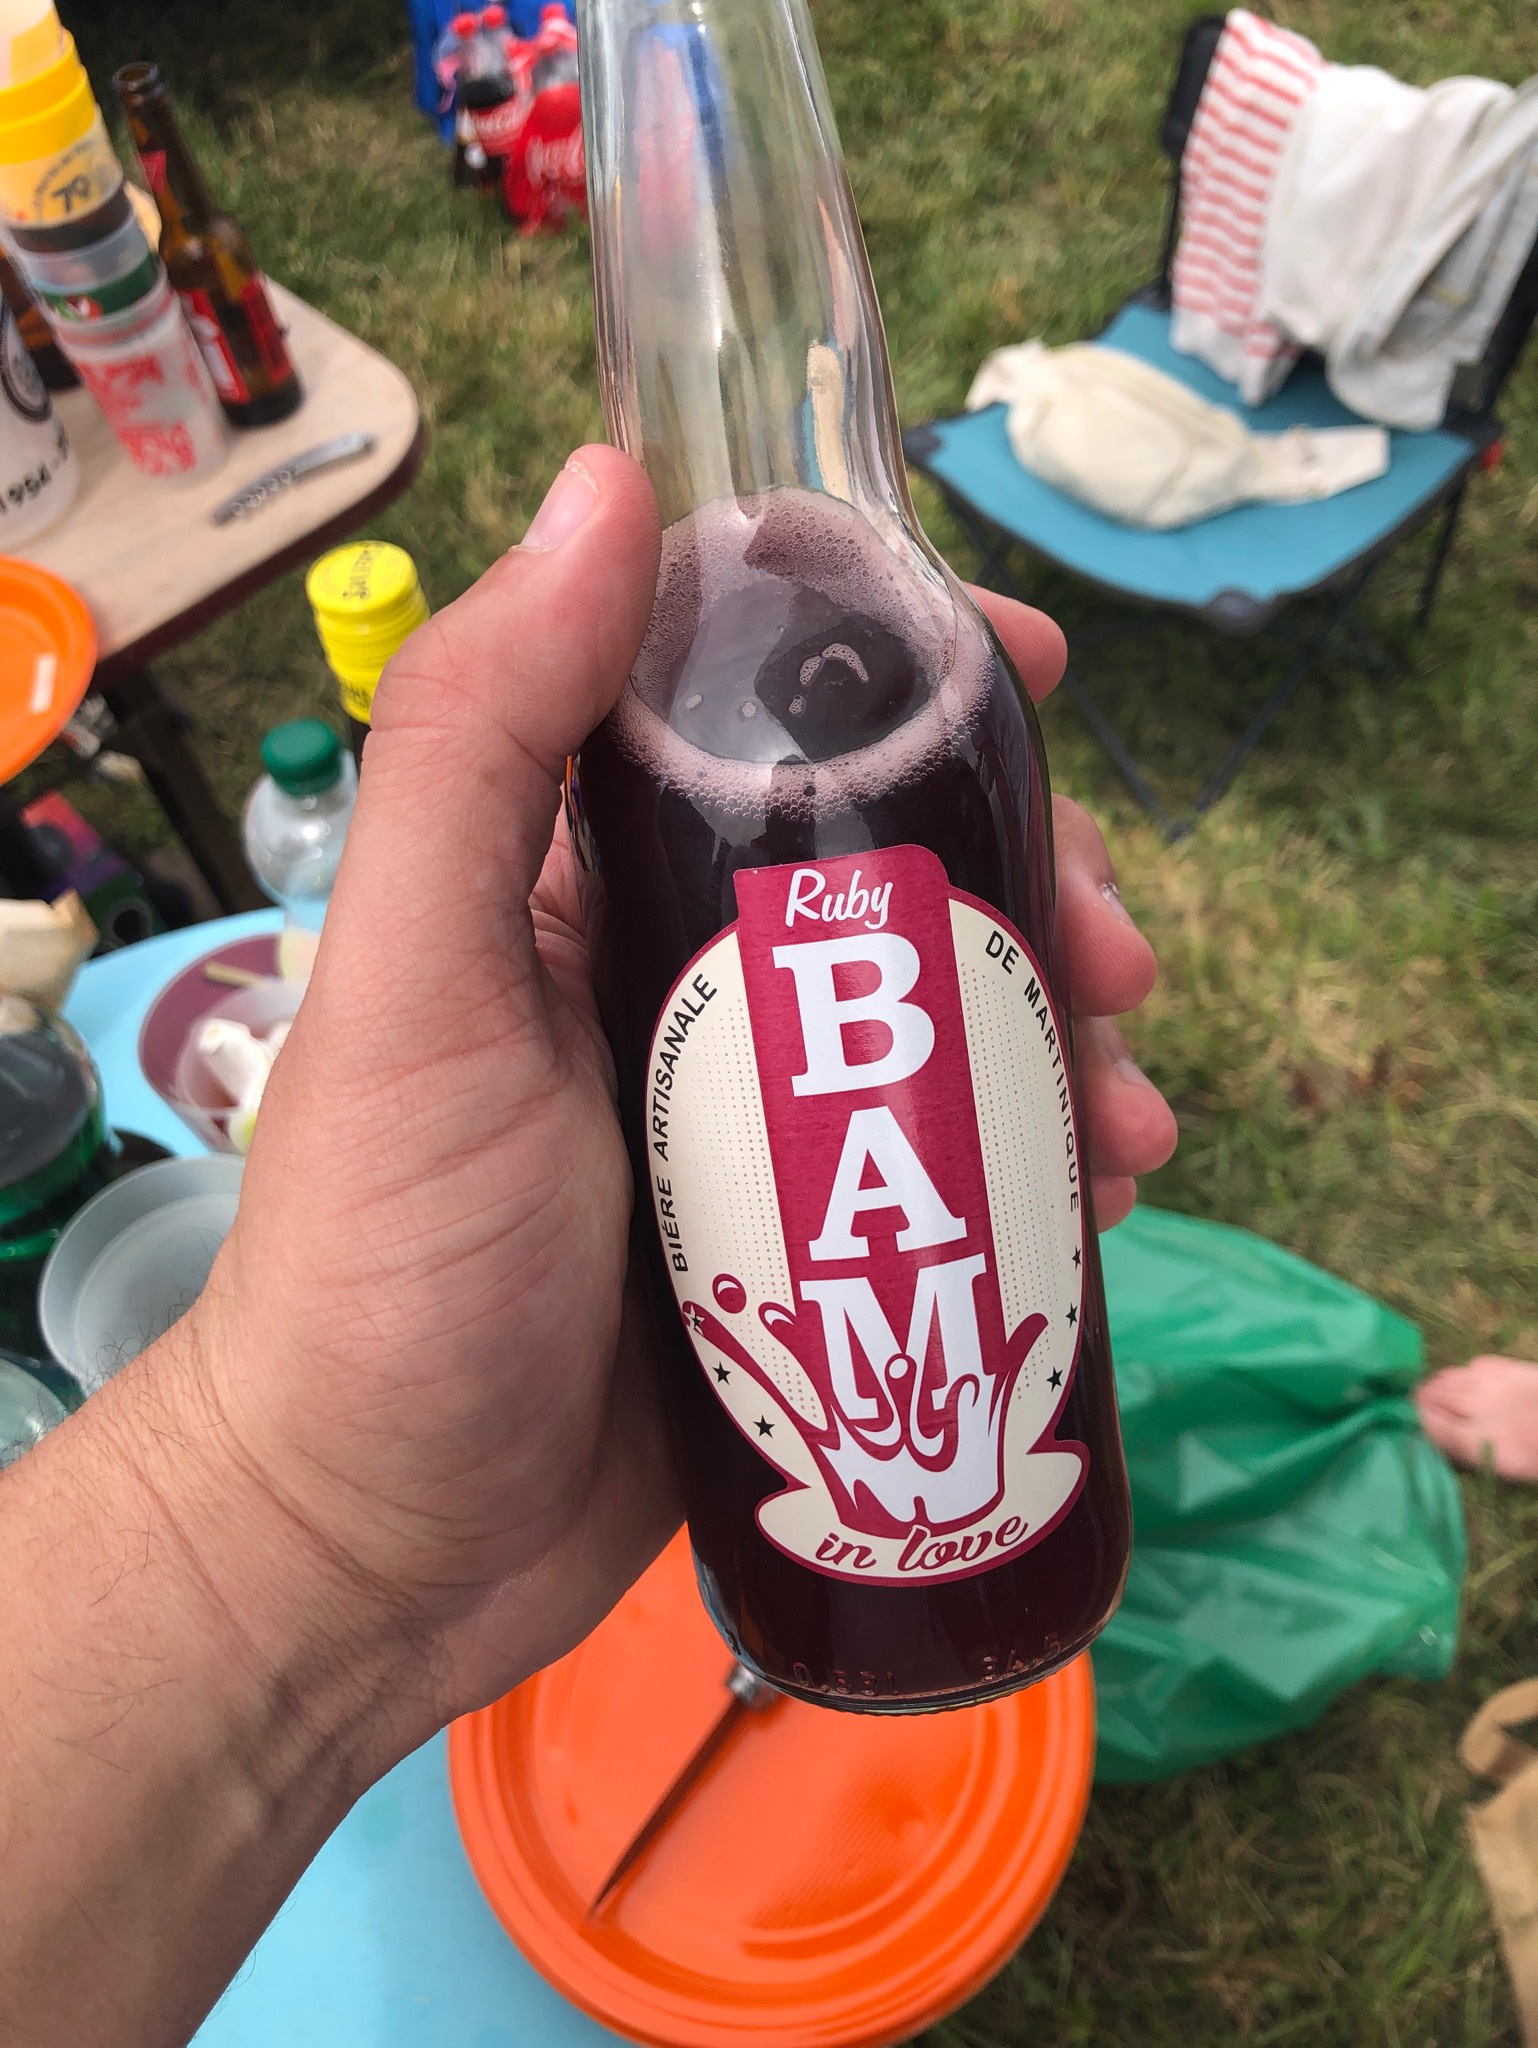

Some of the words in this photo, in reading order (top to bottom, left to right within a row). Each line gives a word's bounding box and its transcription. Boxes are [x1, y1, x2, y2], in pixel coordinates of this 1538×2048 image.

[785, 868, 893, 929] Ruby
[653, 973, 718, 1162] ARTISANALE
[985, 930, 1020, 975] DE
[1023, 976, 1080, 1213] MARTINIQUE
[815, 1532, 877, 1569] in
[897, 1515, 1029, 1572] love
